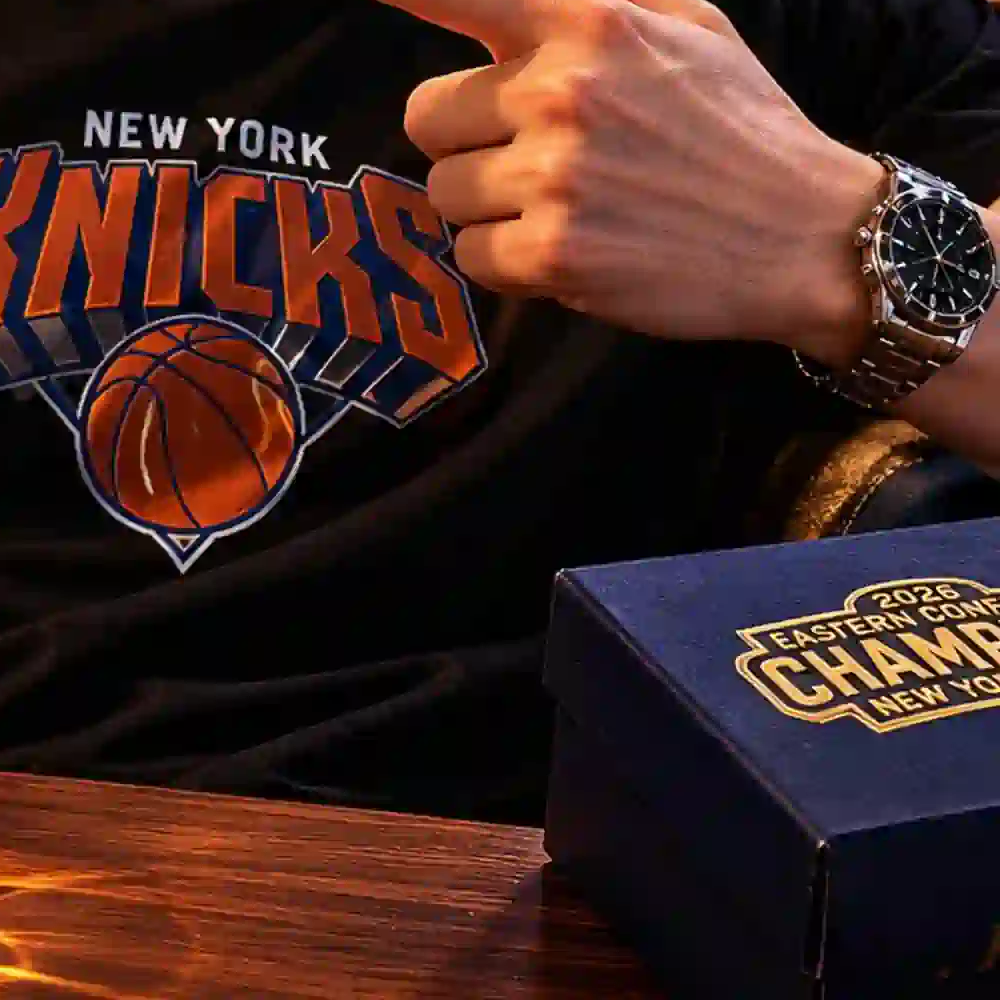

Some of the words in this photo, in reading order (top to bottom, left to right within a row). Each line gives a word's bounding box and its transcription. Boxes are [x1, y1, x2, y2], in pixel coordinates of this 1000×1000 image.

[83, 109, 188, 150] NEW
[206, 116, 331, 171] YORK
[872, 584, 961, 610] 2026
[769, 610, 918, 650] EASTERN
[868, 684, 949, 716] NEW
[948, 672, 1000, 697] YO
